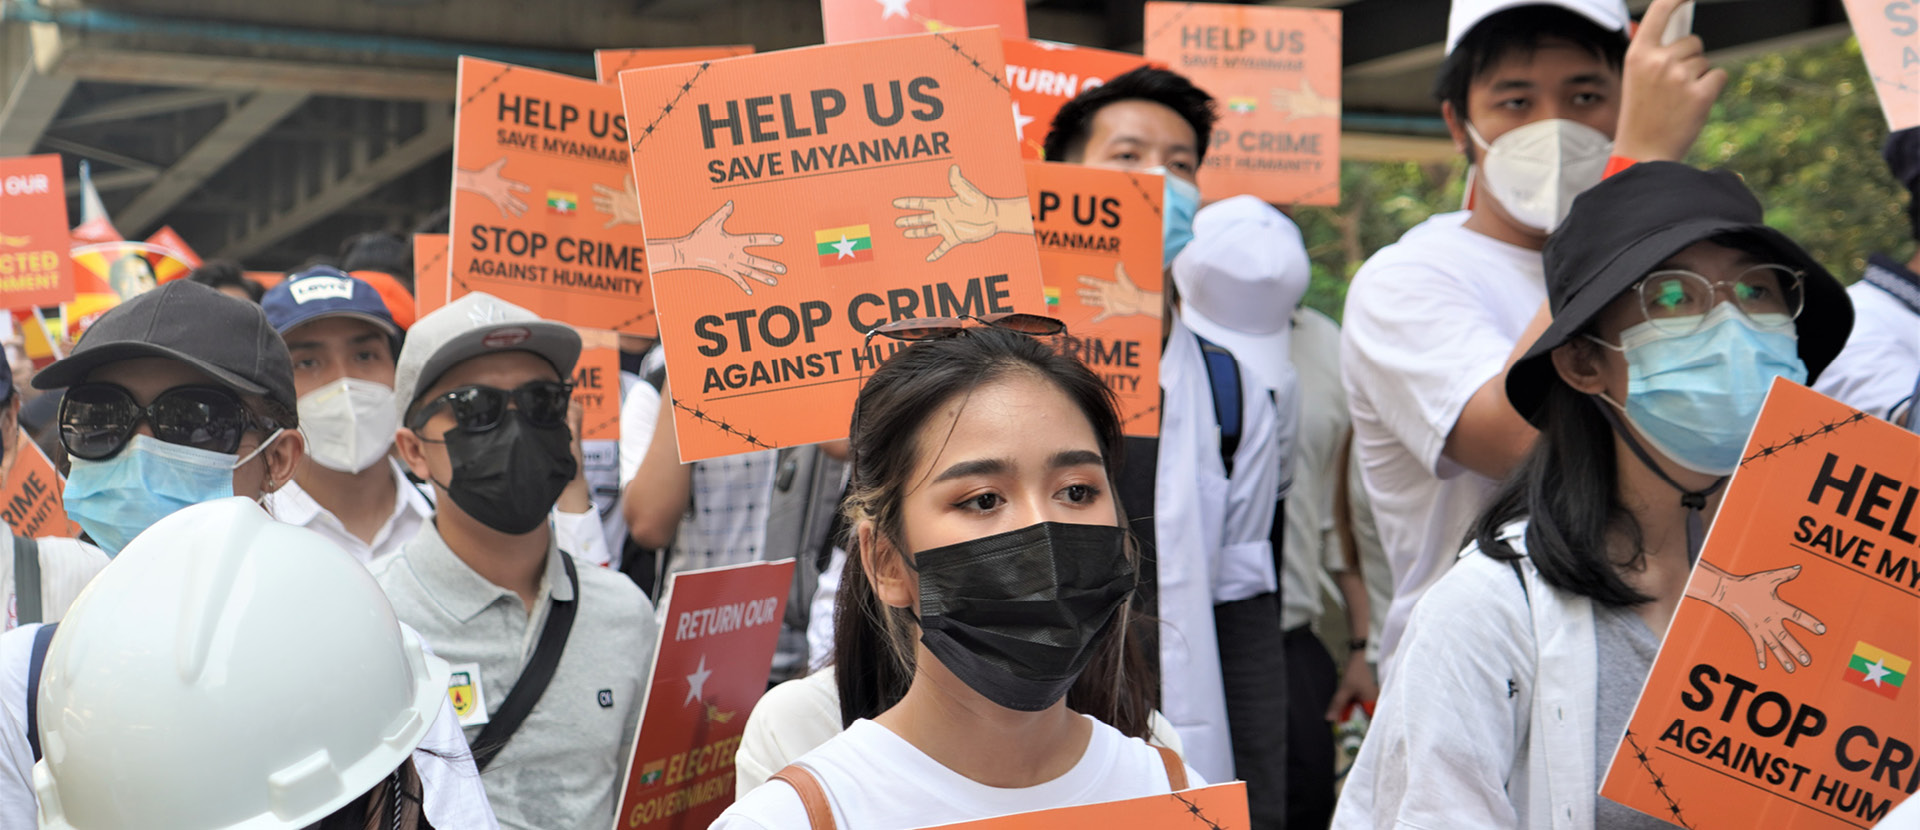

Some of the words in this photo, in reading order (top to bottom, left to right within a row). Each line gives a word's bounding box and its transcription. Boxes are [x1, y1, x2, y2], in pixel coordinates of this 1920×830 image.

[1181, 26, 1256, 52] HELP
[1265, 30, 1305, 54] US
[1884, 0, 1920, 37] S
[1183, 54, 1218, 68] SAVE
[1224, 56, 1304, 72] MYANMAR
[498, 93, 579, 132] HELP
[589, 109, 629, 143] US
[698, 88, 847, 149] HELP
[863, 76, 944, 127] US
[497, 129, 537, 151] SAVE
[543, 137, 629, 165] MYANMAR
[708, 152, 784, 183] SAVE
[790, 131, 951, 173] MYANMAR
[1238, 130, 1323, 155] CRIME
[5, 173, 49, 196] OUR
[1236, 156, 1323, 174] HUMANITY
[1032, 191, 1061, 222] P
[1074, 195, 1121, 229] US
[471, 225, 548, 258] STOP
[556, 236, 643, 273] CRIME
[1034, 230, 1121, 253] YANMAR
[468, 258, 548, 283] AGAINST
[553, 269, 643, 295] HUMANITY
[694, 301, 832, 357] STOP
[702, 349, 842, 393] AGAINST
[1807, 452, 1920, 548] HEL
[1794, 515, 1876, 569] SAVE
[1875, 548, 1920, 593] MY
[675, 602, 745, 641] RETURN
[745, 597, 778, 628] OUR
[1681, 664, 1827, 748] STOP
[1659, 718, 1811, 793] AGAINST
[629, 772, 735, 829] GOVERNMENT
